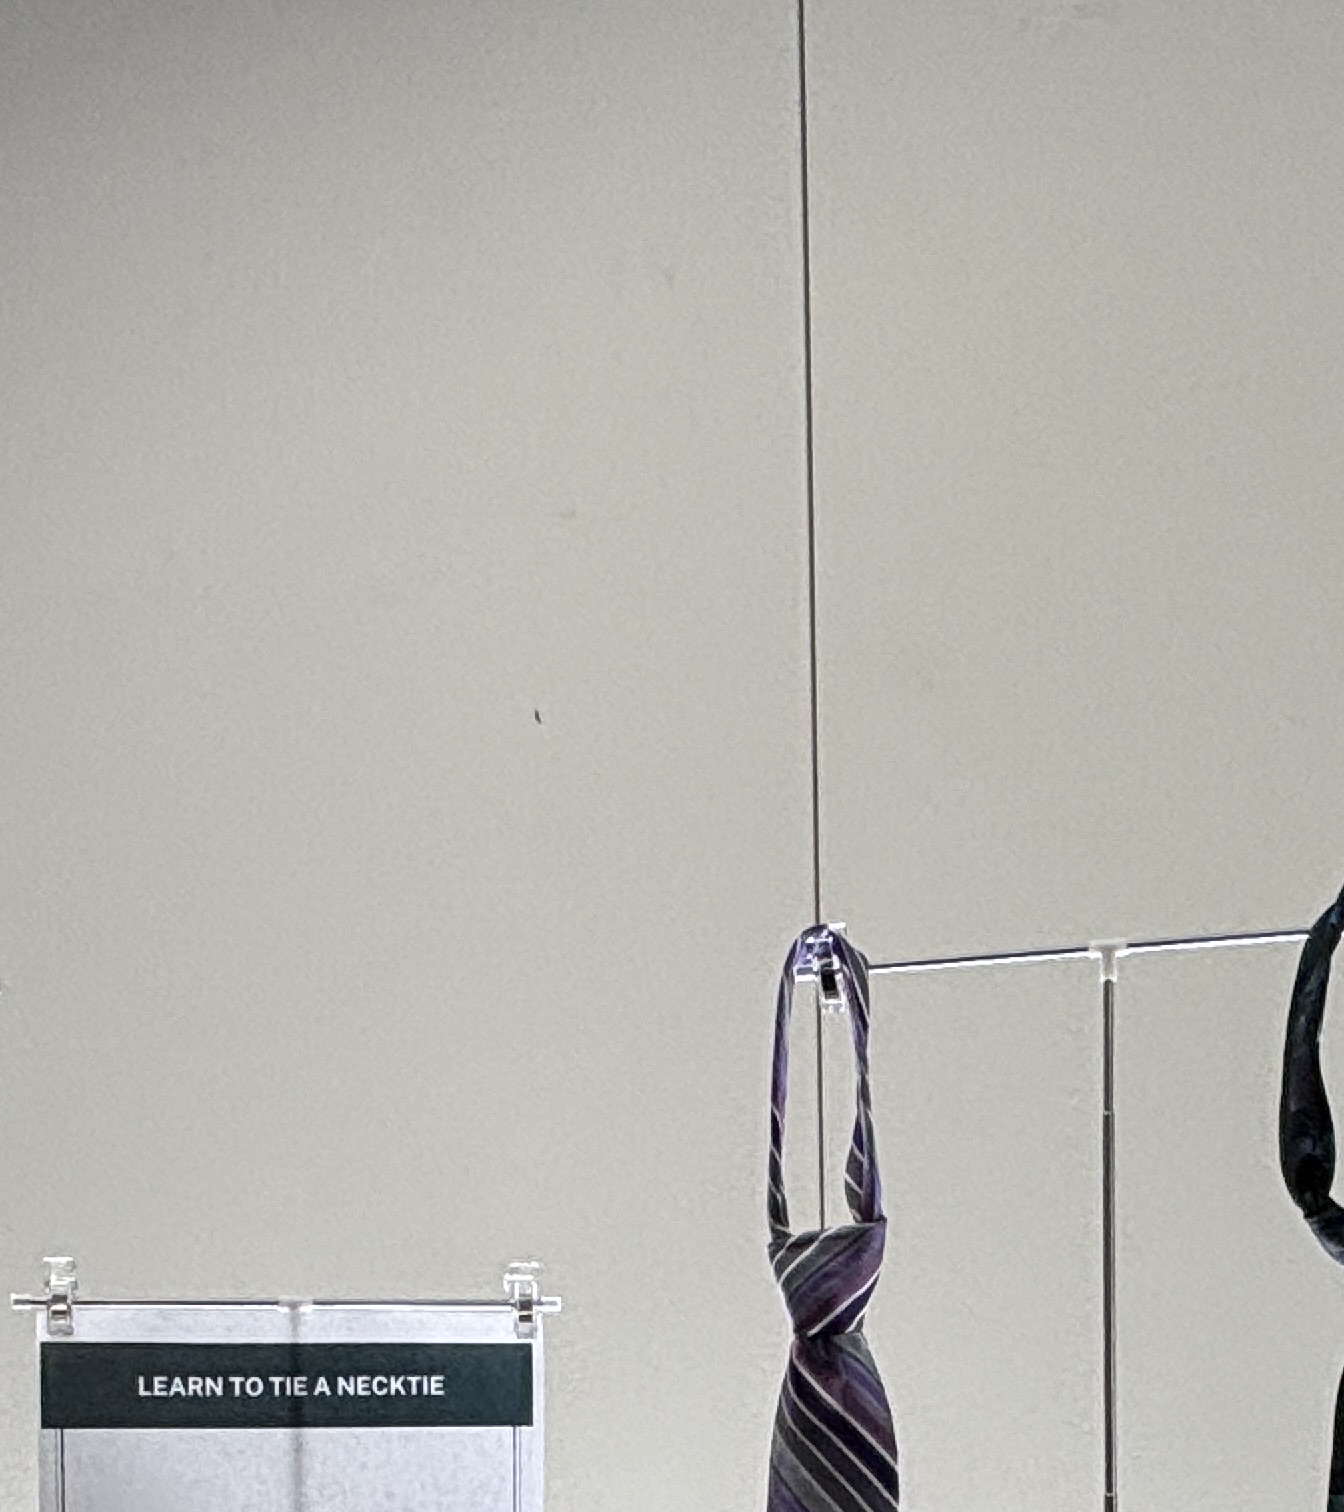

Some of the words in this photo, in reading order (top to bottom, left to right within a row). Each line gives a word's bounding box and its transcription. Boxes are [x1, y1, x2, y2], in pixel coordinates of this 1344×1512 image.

[137, 1374, 224, 1398] LEARN
[228, 1374, 265, 1398] TO
[268, 1374, 308, 1398] TIE
[312, 1374, 332, 1397] A
[336, 1373, 446, 1397] NECKTIE
